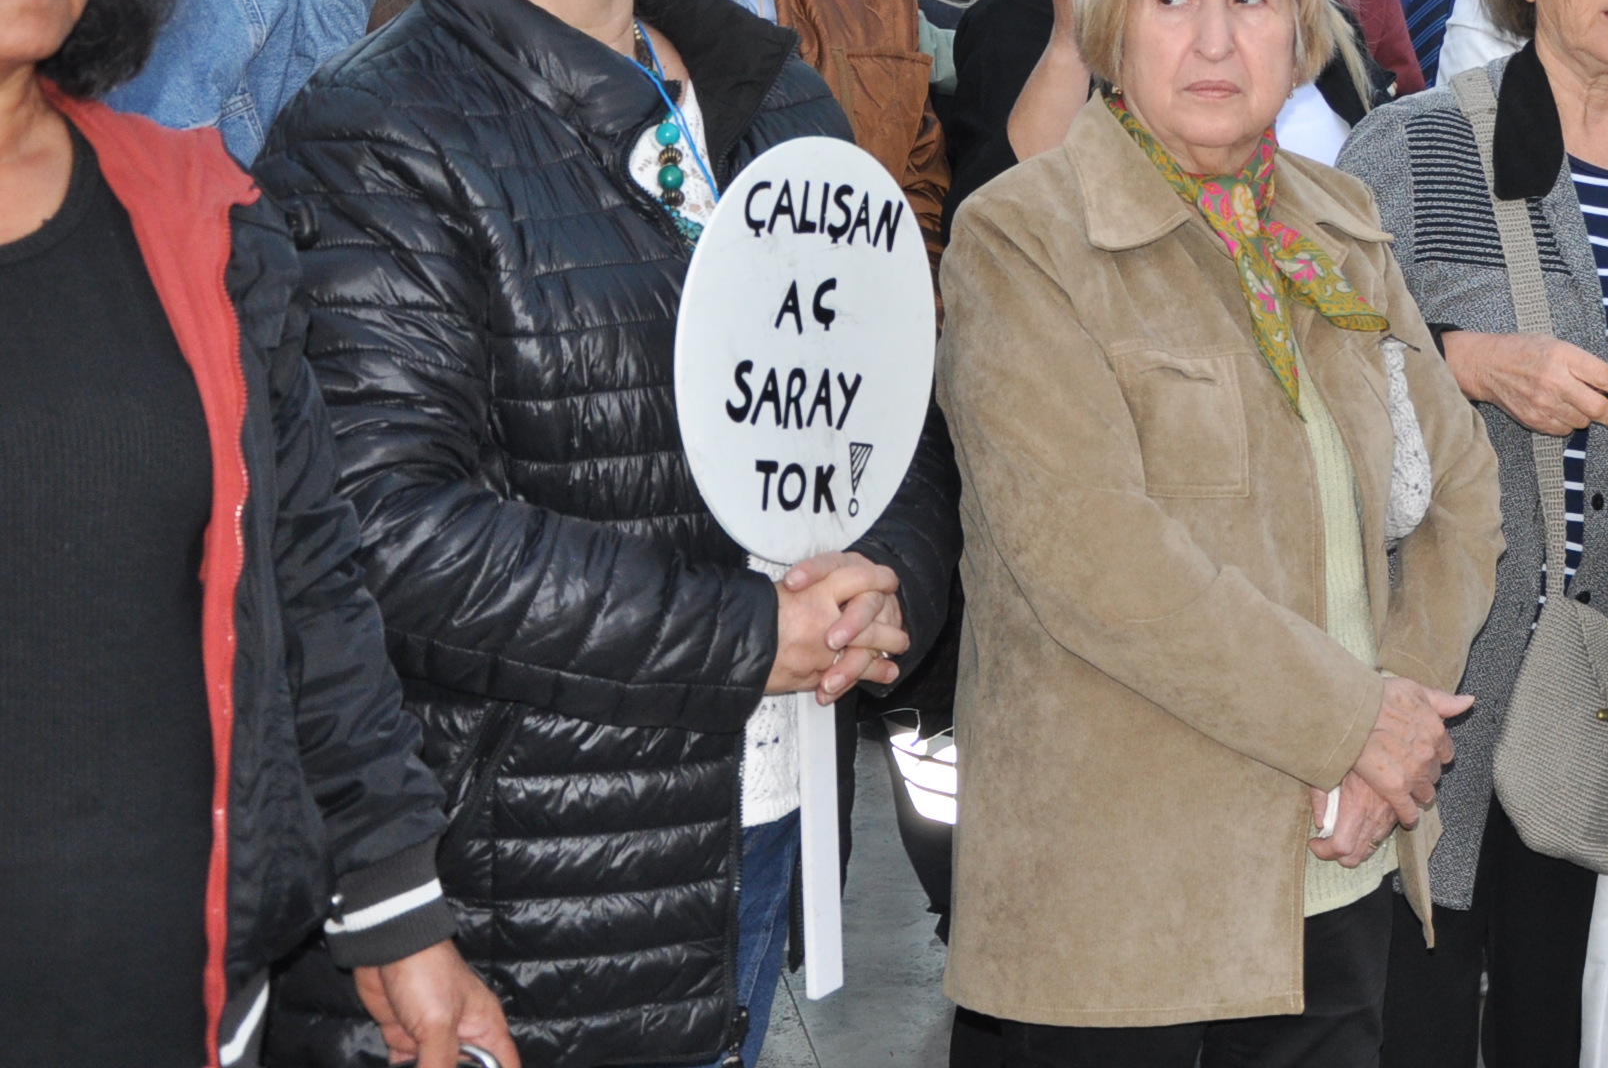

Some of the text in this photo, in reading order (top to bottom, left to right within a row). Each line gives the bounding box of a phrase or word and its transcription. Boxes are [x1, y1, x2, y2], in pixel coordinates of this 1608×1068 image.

[744, 178, 906, 253] ÇALIŞAN
[774, 277, 837, 335] AÇ
[725, 360, 862, 431] SARAY
